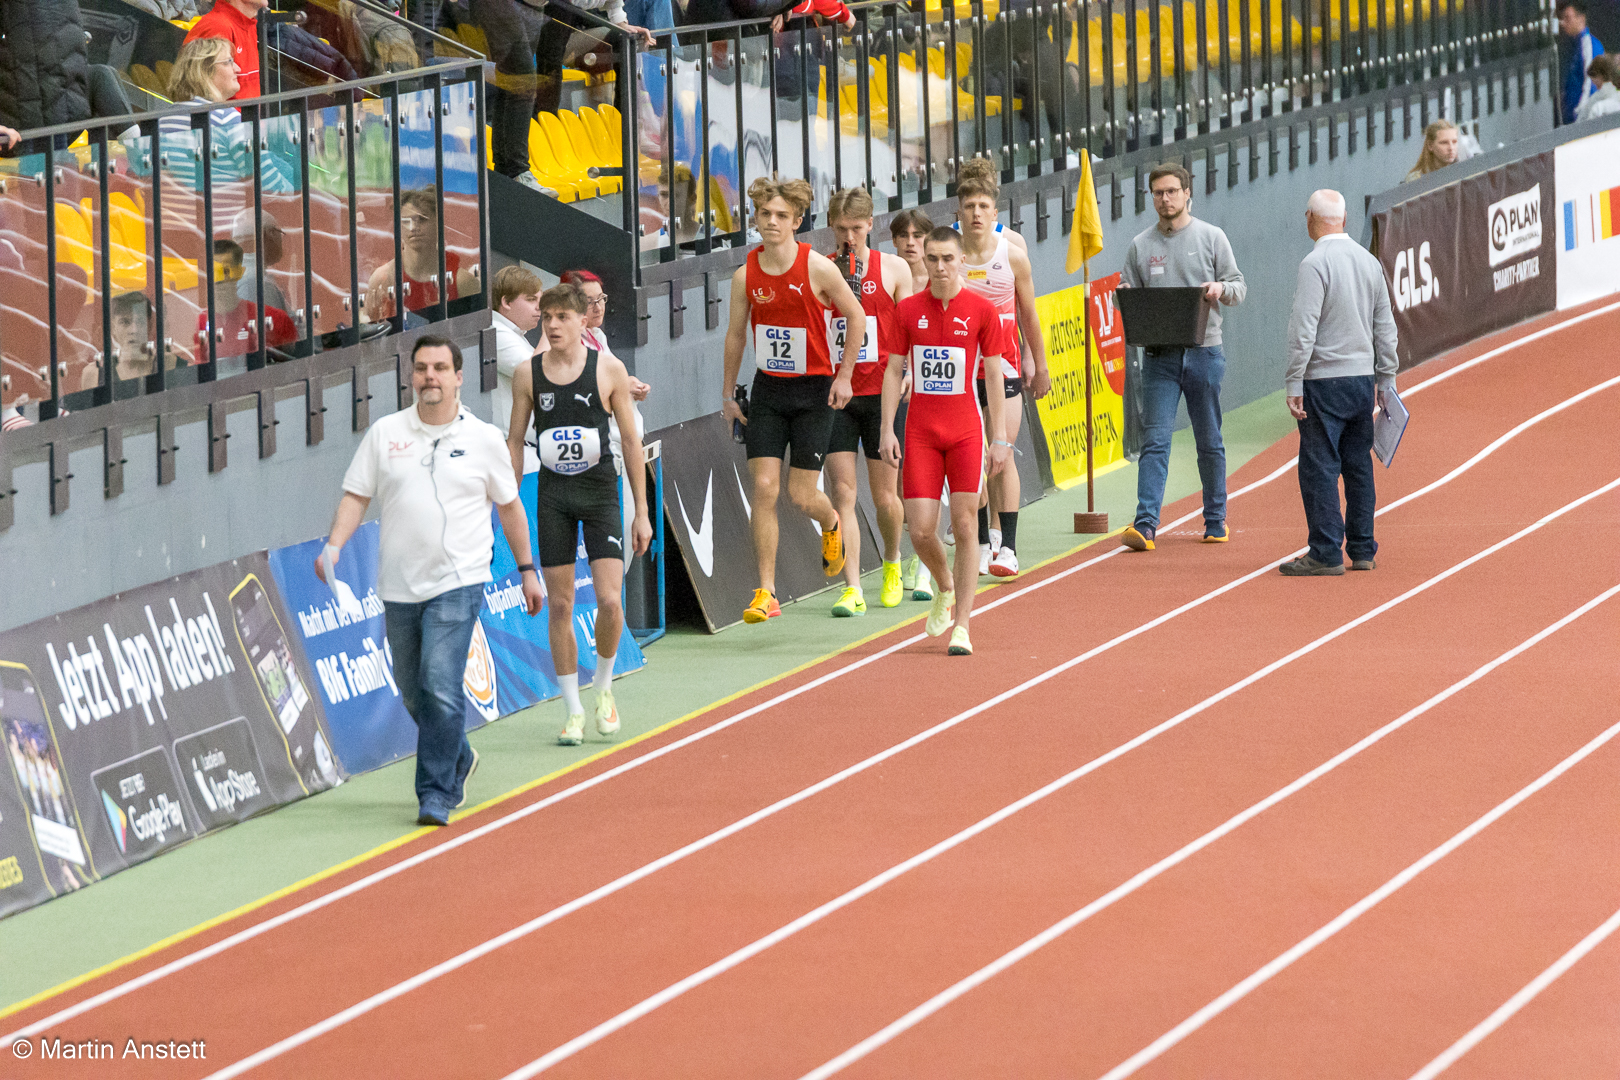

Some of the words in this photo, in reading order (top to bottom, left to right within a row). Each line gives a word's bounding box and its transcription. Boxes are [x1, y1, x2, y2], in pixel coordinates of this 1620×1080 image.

[1509, 200, 1538, 232] PLAN
[1393, 240, 1440, 312] GLS.
[1492, 255, 1540, 293] CHARITY-PARTNER
[770, 341, 792, 359] 12
[835, 331, 869, 348] 40
[1050, 315, 1085, 356] DEUTSCHE
[921, 361, 956, 379] 640
[557, 442, 583, 461] 29
[45, 642, 121, 731] Jetzt
[103, 622, 168, 726] App
[144, 591, 236, 692] laden!
[315, 654, 351, 705] BIG
[338, 636, 399, 697] Family
[127, 798, 167, 843] Google
[157, 793, 188, 833] Play
